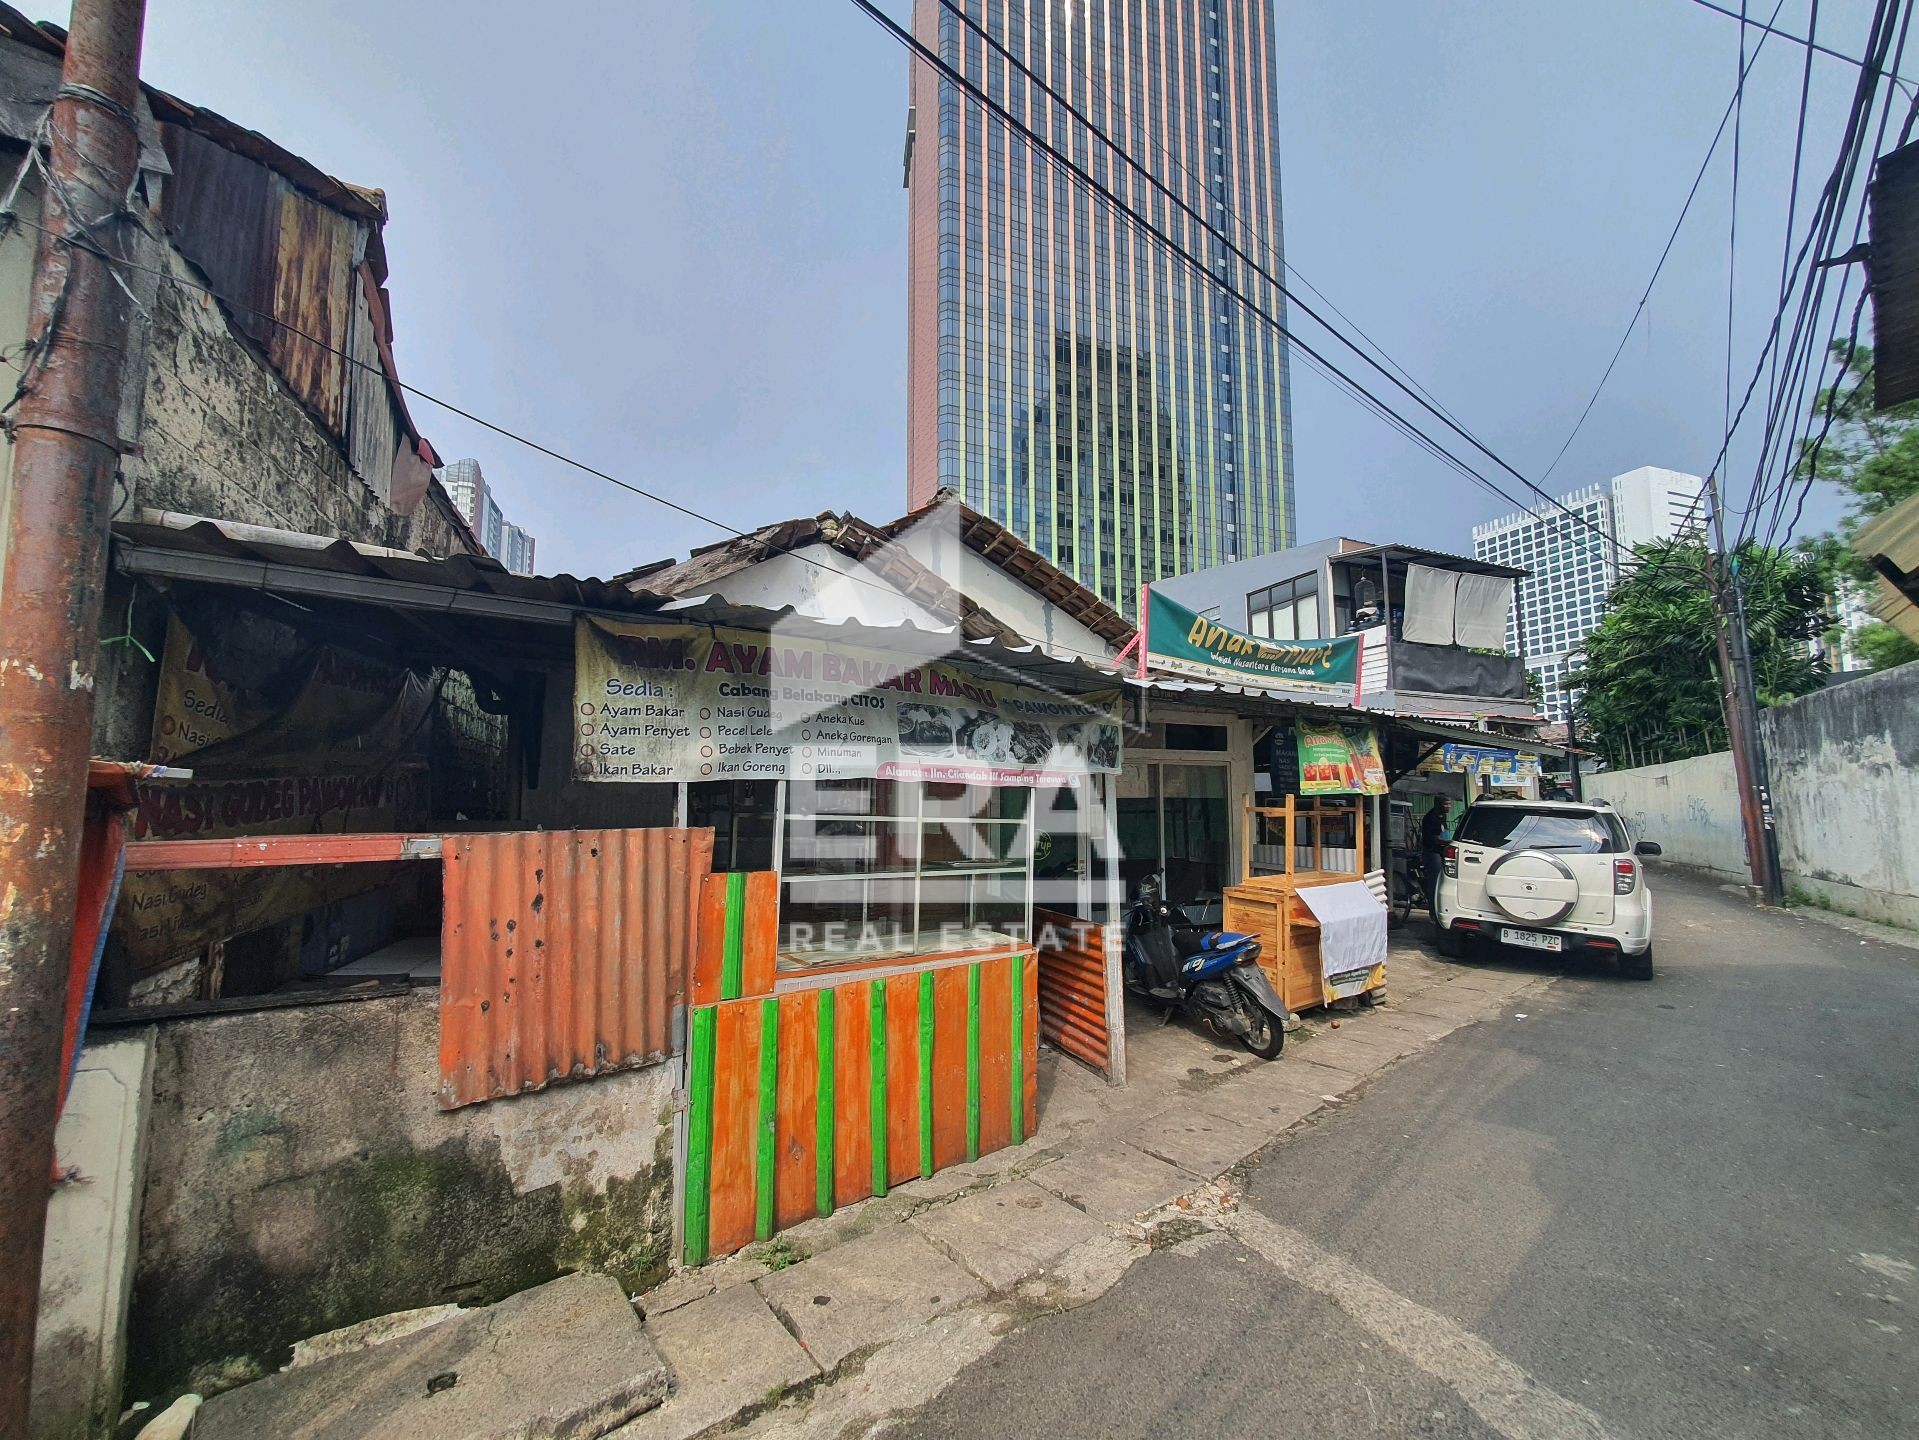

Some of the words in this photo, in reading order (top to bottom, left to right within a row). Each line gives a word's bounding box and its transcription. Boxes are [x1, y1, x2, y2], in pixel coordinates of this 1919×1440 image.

[1188, 615, 1256, 656] Anak
[705, 641, 813, 680] AYAM
[822, 653, 923, 693] BAKAR
[929, 669, 998, 709] MADU
[719, 682, 778, 699] Cabang
[782, 687, 847, 706] Belakang
[850, 694, 885, 709] CITOS
[600, 704, 641, 718] Ayam
[645, 704, 684, 717] Bakar
[717, 707, 745, 718] Nasi
[747, 707, 783, 721] Gudeg
[815, 713, 846, 724] Aneka
[848, 715, 865, 726] Kue
[600, 724, 641, 737] Ayam
[644, 725, 690, 738] Penyet
[718, 725, 747, 736] Pecel
[750, 725, 773, 736] Lele
[816, 729, 848, 740] Aneka
[849, 732, 892, 745] Gorengan
[599, 743, 636, 755] Sate
[719, 743, 752, 754] Bebek
[755, 744, 794, 757] Penyet
[817, 747, 862, 758] Minuman
[599, 763, 628, 775] Ikan
[632, 763, 673, 775] Bakar
[717, 761, 740, 773] Ikan
[742, 761, 785, 774] Goreng
[885, 766, 922, 778] Alamat
[1503, 929, 1509, 938] B
[1514, 931, 1537, 943] 1825
[1541, 935, 1560, 946] PZC
